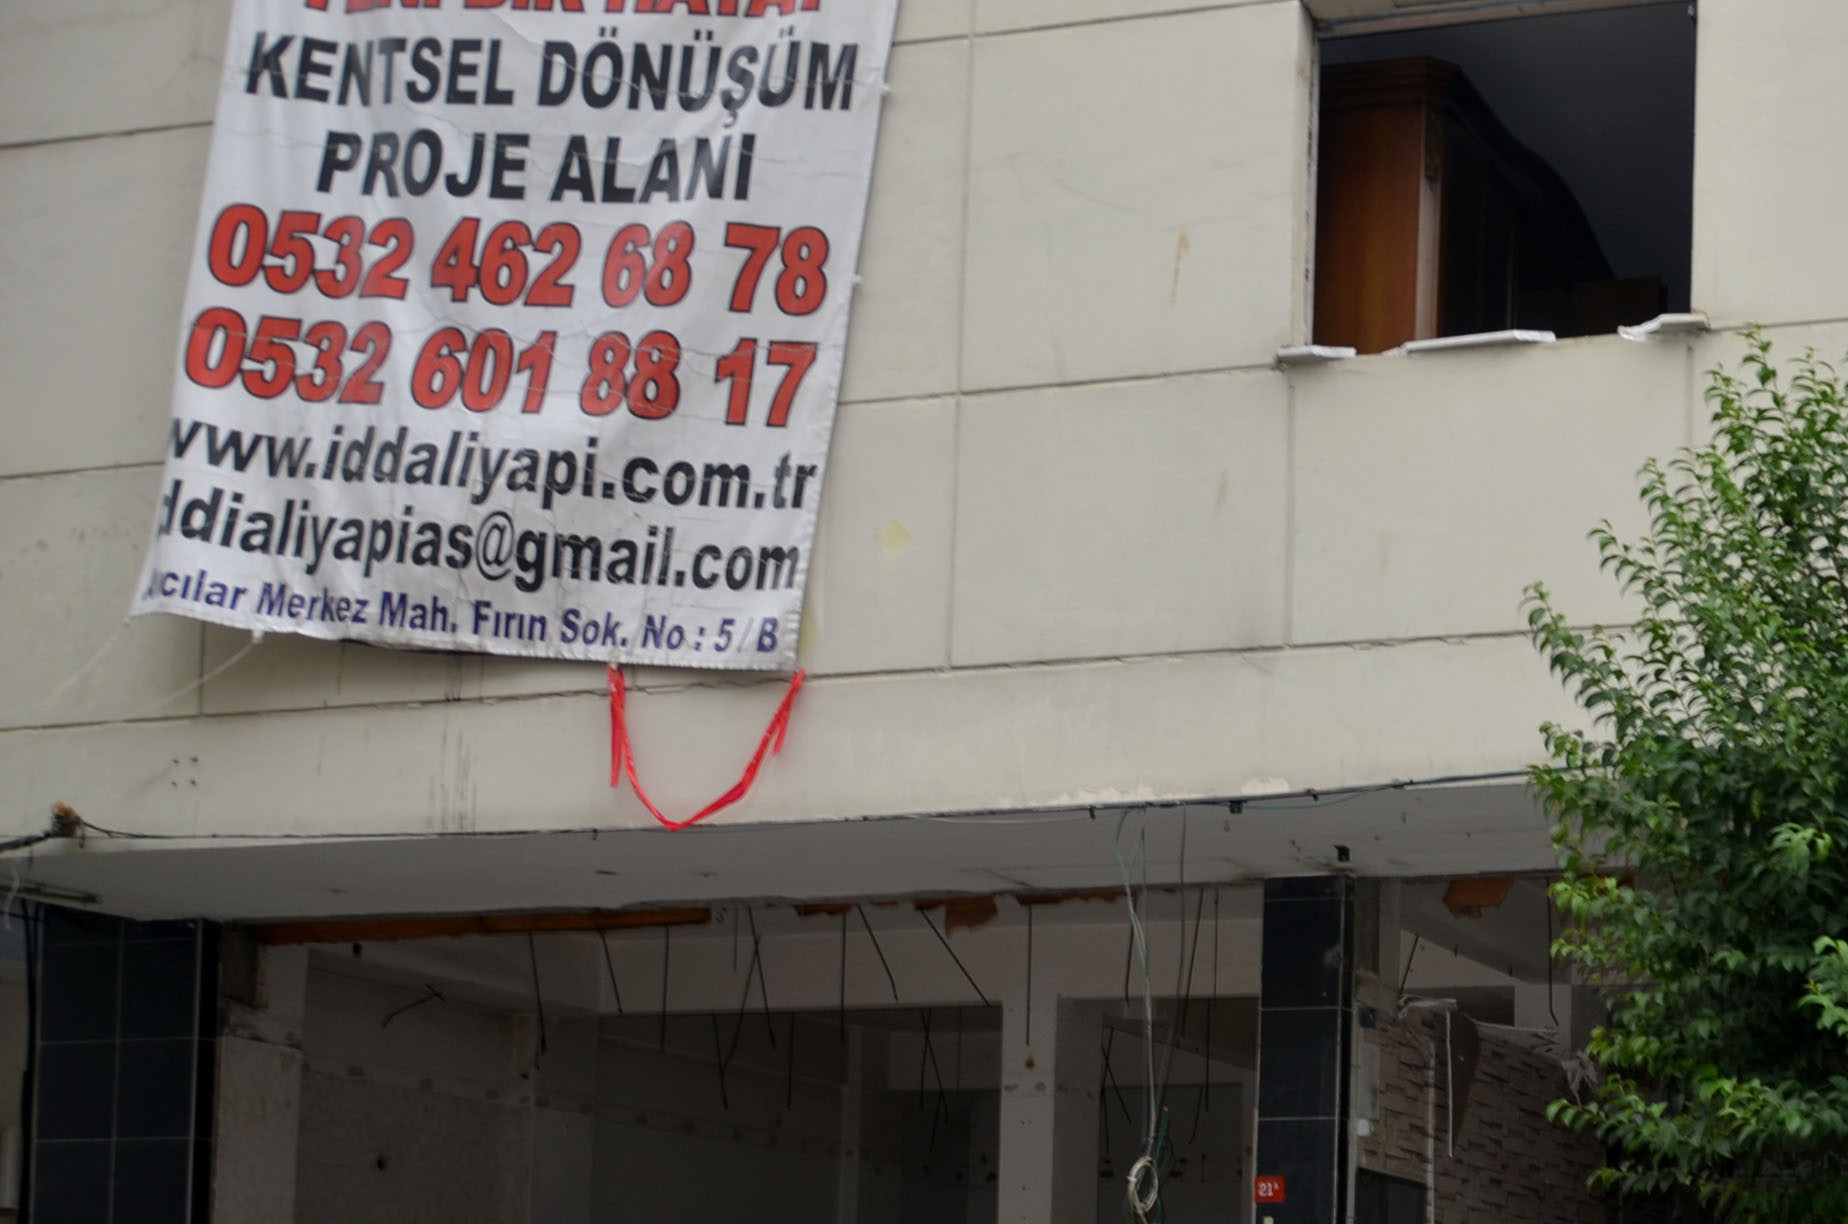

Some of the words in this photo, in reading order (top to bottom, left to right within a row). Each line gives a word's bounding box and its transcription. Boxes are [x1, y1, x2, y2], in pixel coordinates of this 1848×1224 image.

[244, 31, 515, 107] KENTSEL
[537, 26, 859, 127] DÖNÜŞÜM
[316, 129, 530, 200] PROJE
[549, 132, 757, 204] ALANI
[208, 203, 415, 300] 0532
[431, 216, 582, 307] 462
[602, 220, 695, 308] 68
[724, 221, 830, 317] 78
[185, 306, 393, 405] 0532
[411, 326, 558, 414] 601
[580, 329, 682, 420] 88
[714, 337, 819, 427] 17
[256, 581, 370, 624] Merkez
[379, 591, 458, 634] Mah.
[472, 600, 547, 642] Fırın
[560, 607, 628, 648] Sok.
